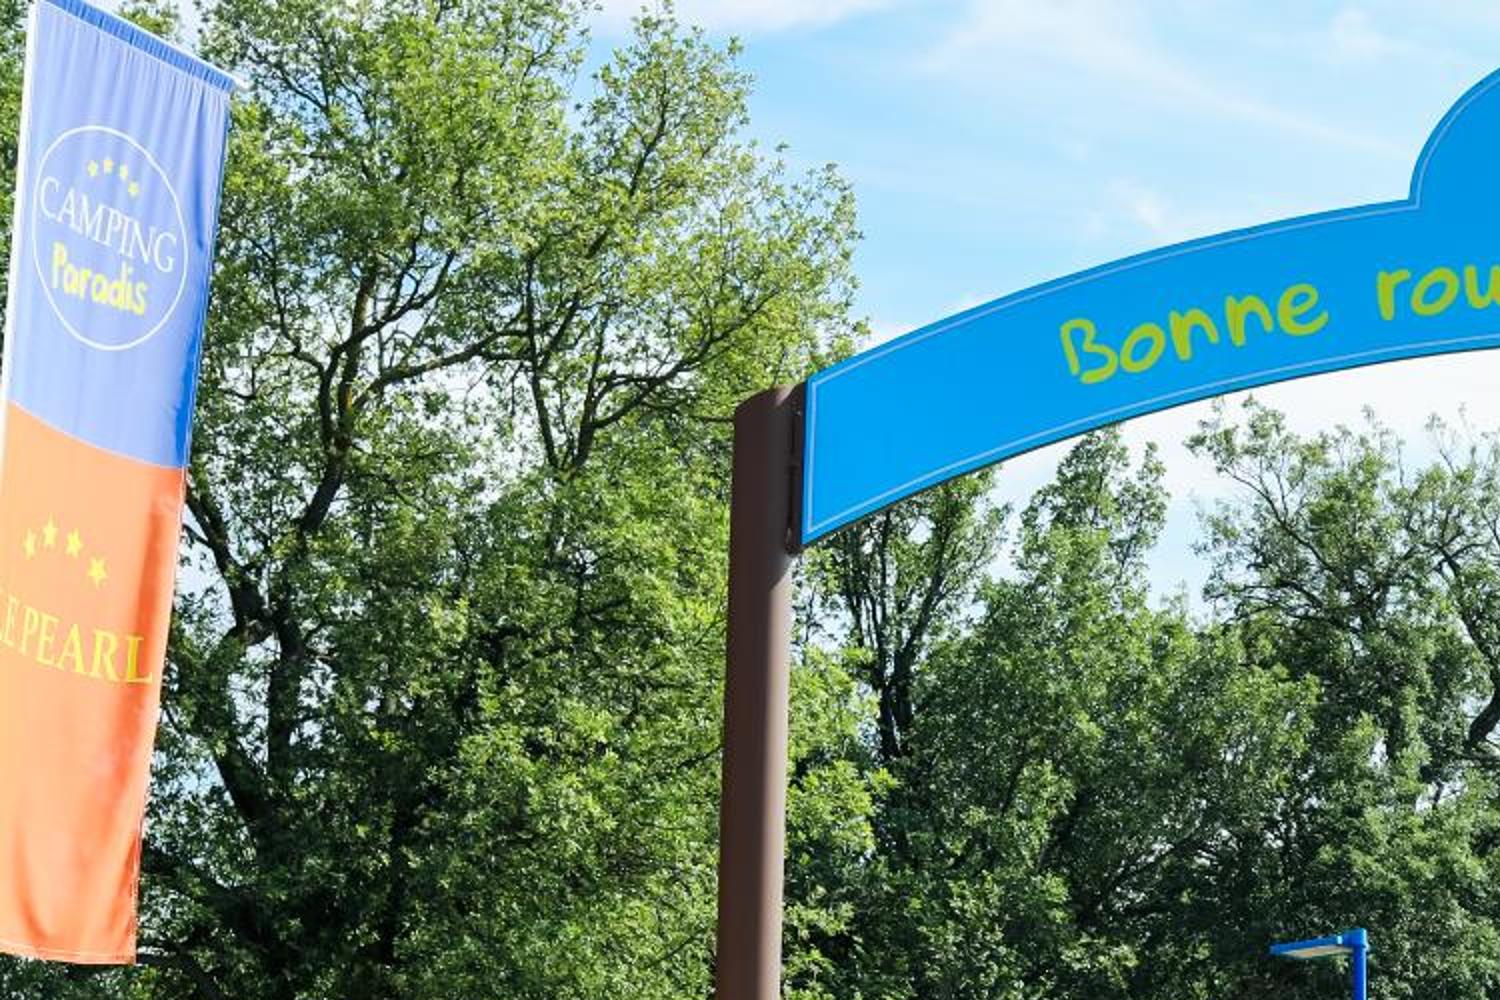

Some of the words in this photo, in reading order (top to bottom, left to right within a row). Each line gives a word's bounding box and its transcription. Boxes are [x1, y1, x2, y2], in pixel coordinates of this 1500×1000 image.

[40, 176, 177, 273] CAMPING
[52, 240, 147, 316] Paradis
[1059, 283, 1329, 384] Bonne
